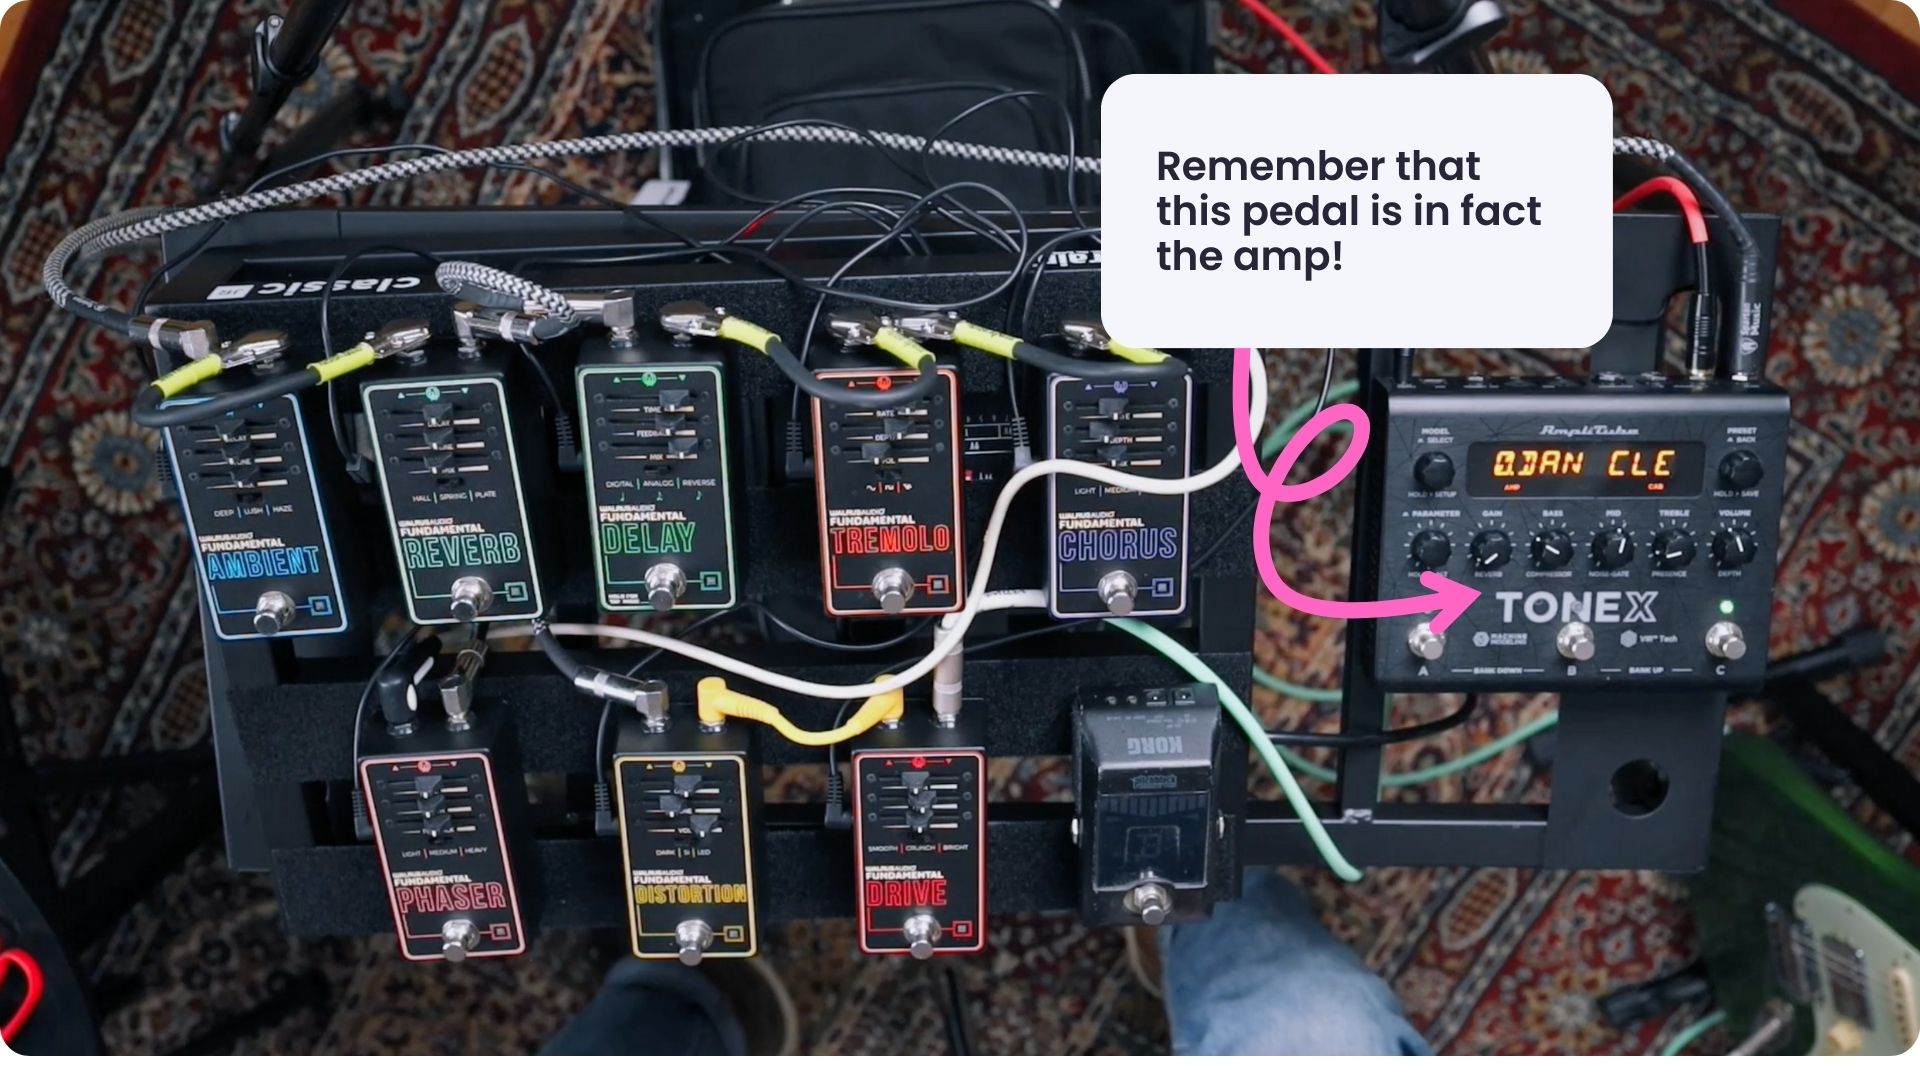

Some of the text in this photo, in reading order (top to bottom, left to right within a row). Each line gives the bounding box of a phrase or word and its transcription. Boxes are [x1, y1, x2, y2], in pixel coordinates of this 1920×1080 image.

[257, 277, 420, 297] classic
[1608, 450, 1675, 477] CLE
[605, 479, 716, 488] DIGITAL ANALOG REVERSE
[600, 511, 687, 522] FUNDAMENTAL
[1412, 510, 1461, 518] PARAMETER
[1606, 509, 1621, 517] MID
[1659, 509, 1690, 517] TREBLE
[1719, 509, 1752, 517] VOLUME
[829, 514, 916, 527] FUNDAMENTAL
[1058, 518, 1145, 530] FUNDAMENTAL
[400, 523, 485, 538] FUNDAMENTAL
[601, 522, 696, 554] DELAY
[829, 524, 951, 554] TREMOLO
[1058, 527, 1178, 562] CHORUS
[201, 538, 286, 552] FUNDAMENTAL
[402, 532, 521, 569] REVERB
[207, 546, 319, 580] AMBIENT
[1496, 591, 1659, 623] TONEX
[1418, 665, 1429, 676] A
[1567, 665, 1577, 676] B
[1715, 665, 1726, 676] C
[1127, 736, 1183, 756] KORG
[394, 874, 472, 887] FUNDAMENTAL
[633, 875, 712, 884] FUNDAMENTAL
[865, 870, 945, 880] FUNDAMENTAL
[396, 882, 507, 914] PHASER
[634, 883, 748, 905] DISTORTION
[866, 880, 947, 907] DRIVE
